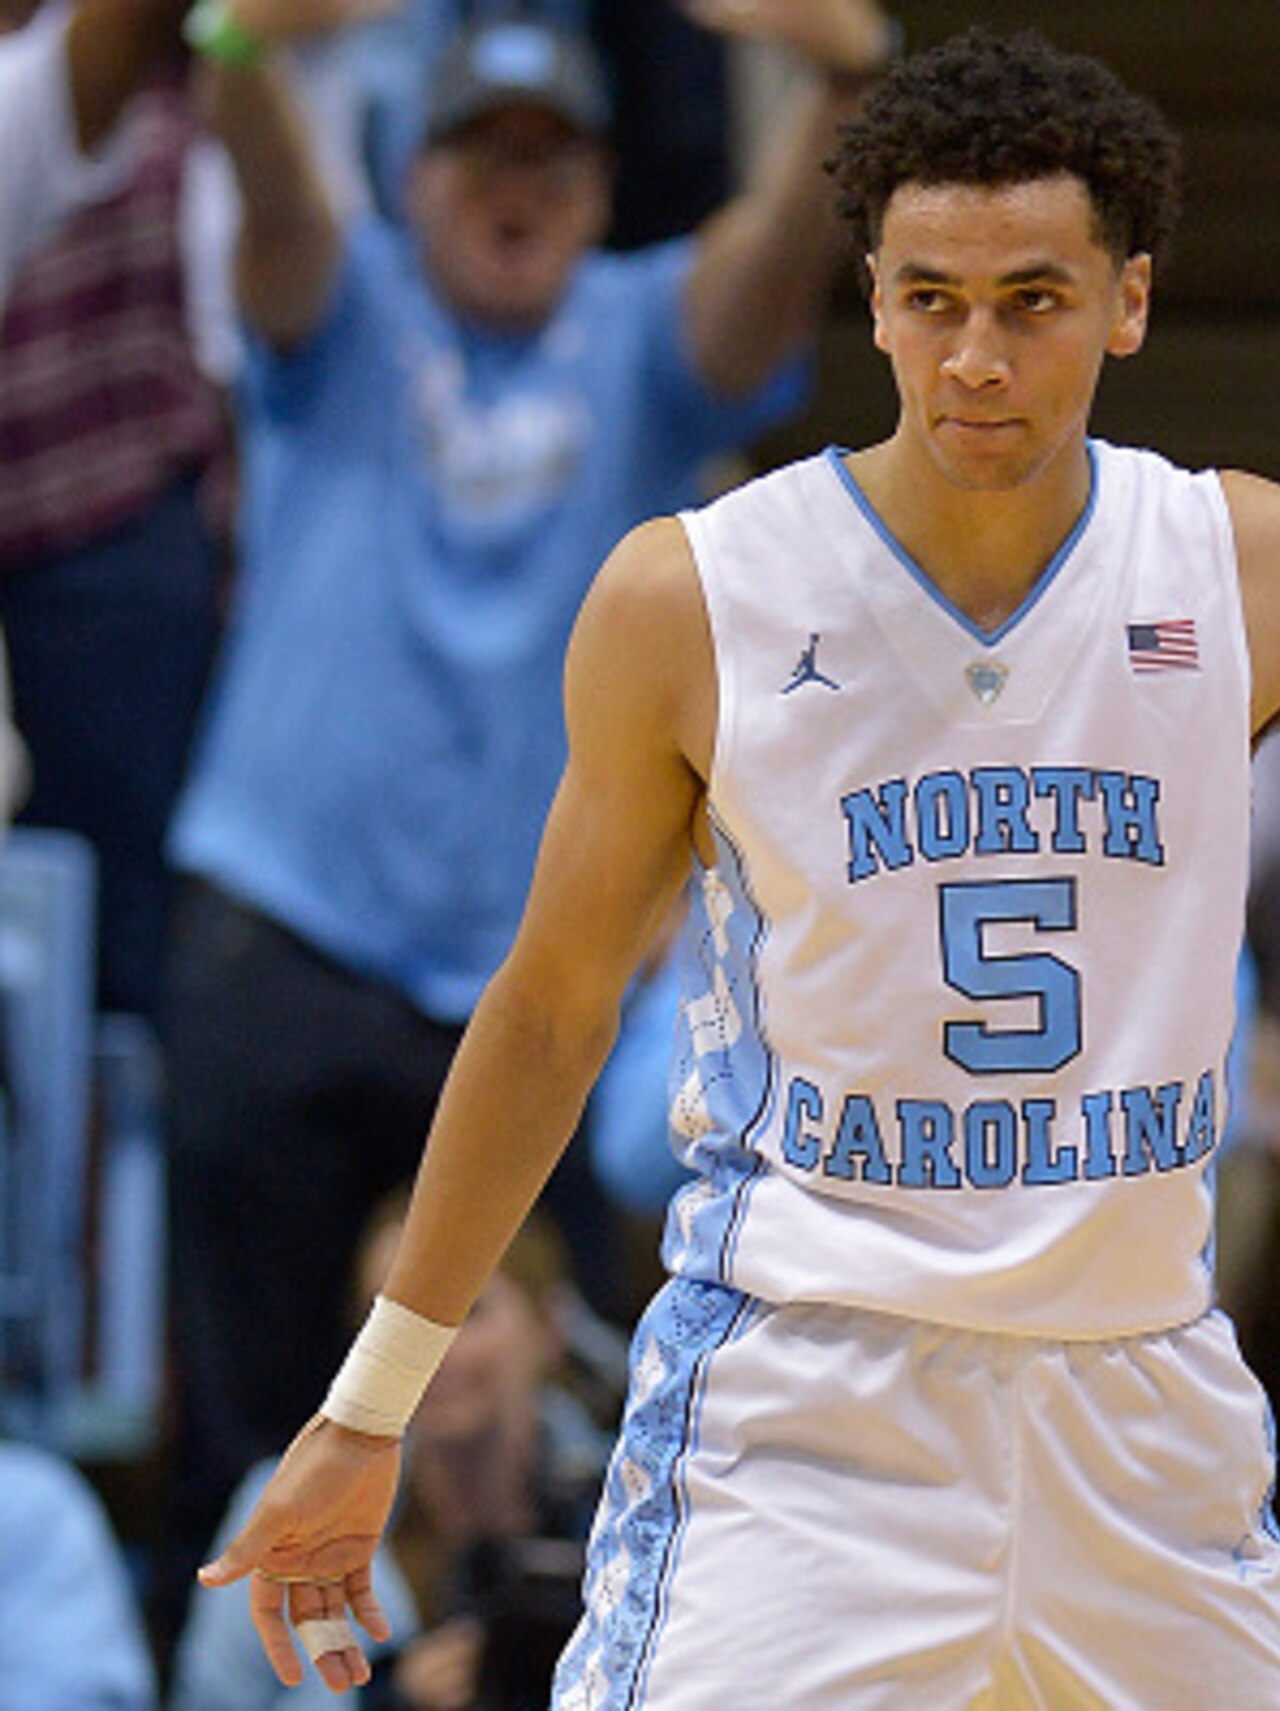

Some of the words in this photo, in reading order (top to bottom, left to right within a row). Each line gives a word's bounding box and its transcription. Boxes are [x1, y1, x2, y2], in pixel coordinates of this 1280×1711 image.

[840, 766, 1165, 883] NORTH
[938, 876, 1082, 1075] 5
[782, 1068, 1216, 1190] CAROLINA
